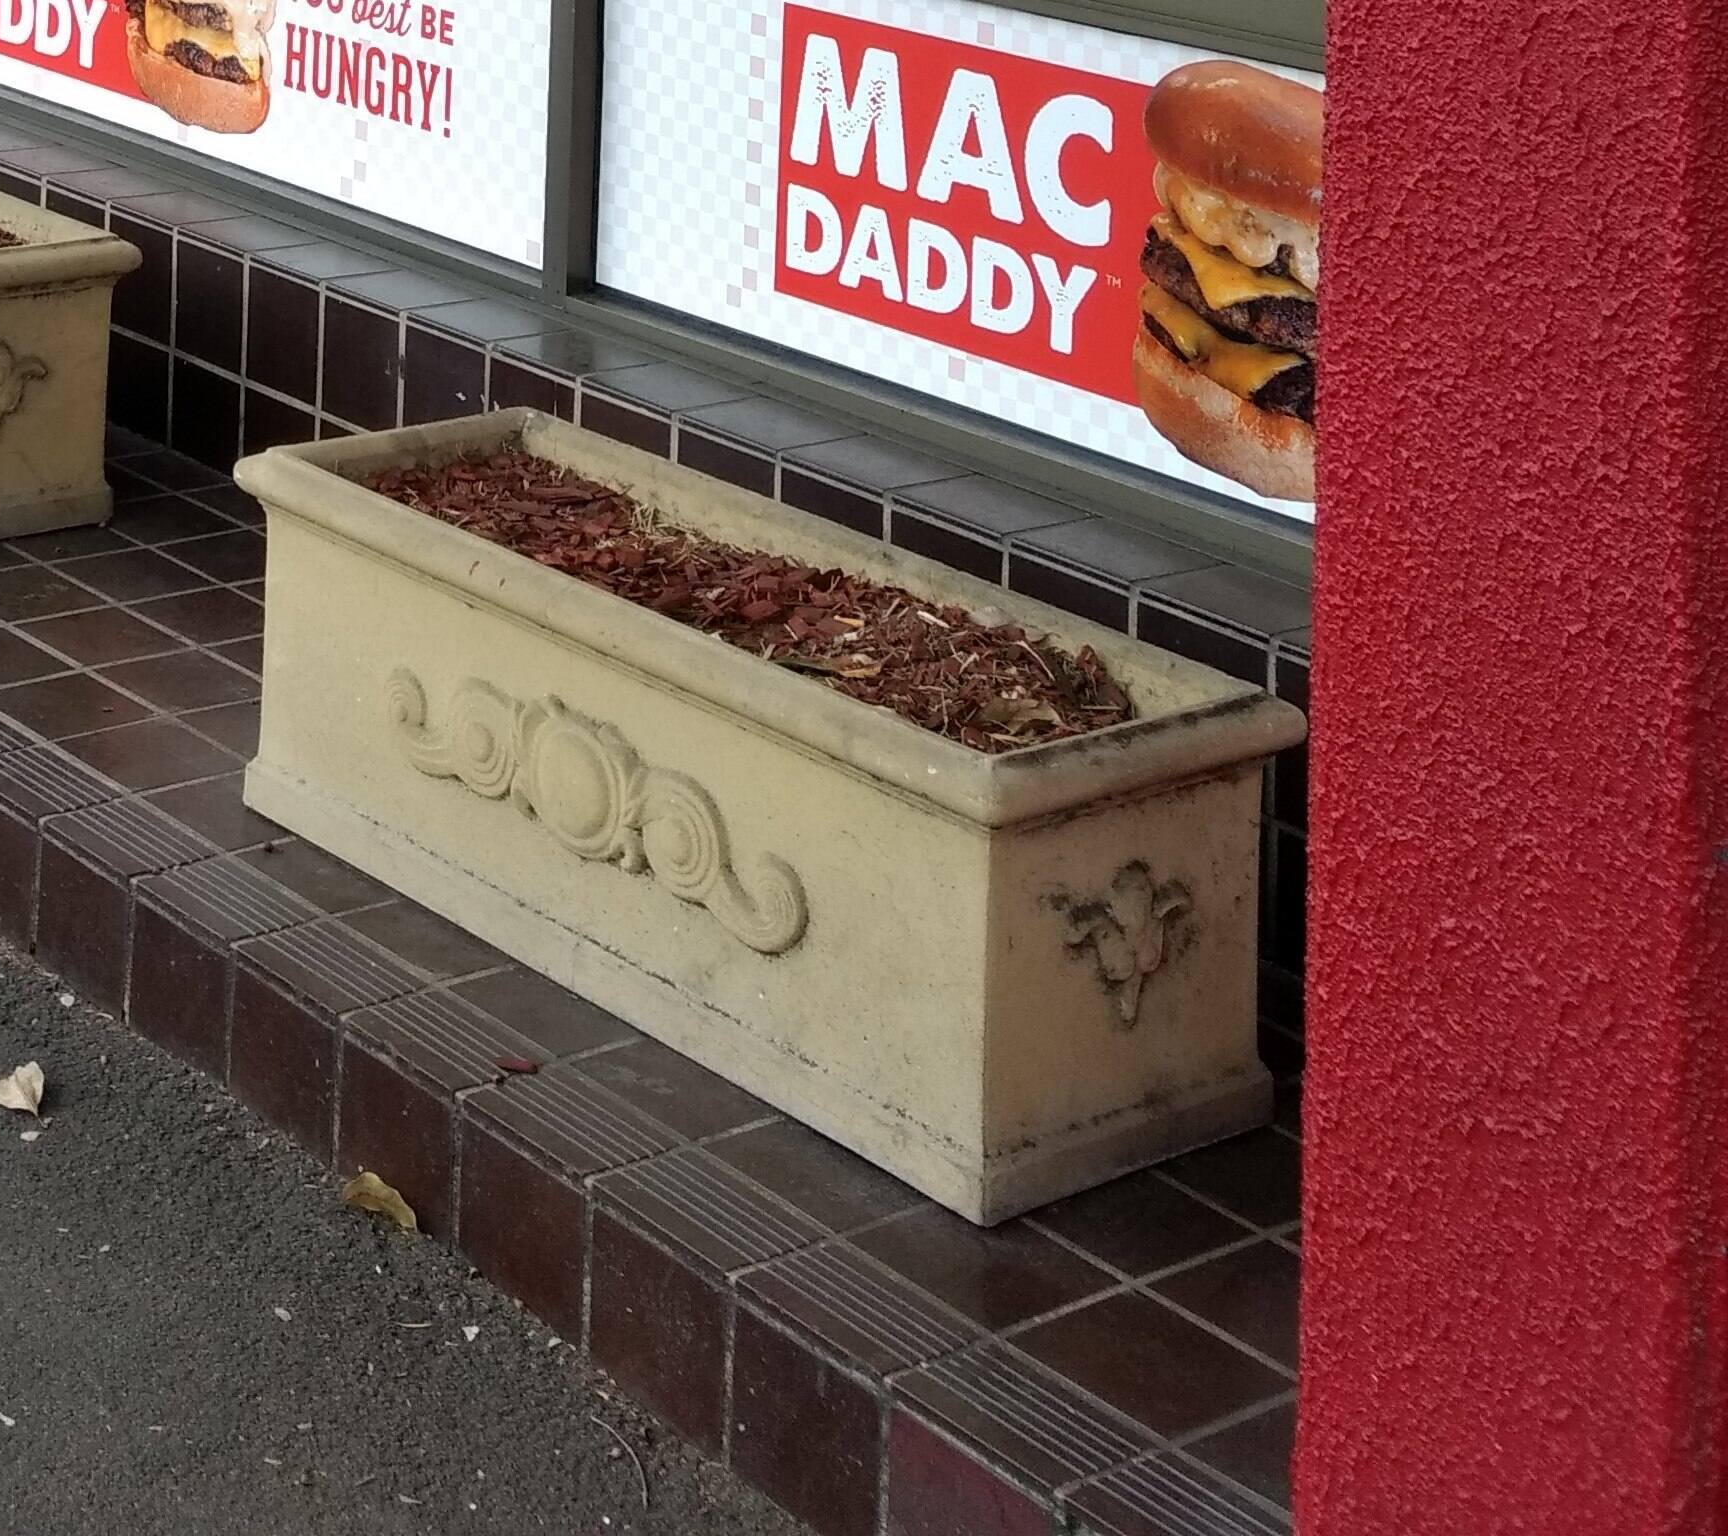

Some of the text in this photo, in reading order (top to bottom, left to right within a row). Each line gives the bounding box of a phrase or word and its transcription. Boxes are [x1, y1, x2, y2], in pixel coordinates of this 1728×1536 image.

[283, 19, 455, 139] HUNGRY!
[420, 5, 456, 48] BE
[788, 32, 1114, 249] MAC
[785, 182, 1098, 356] DADDY
